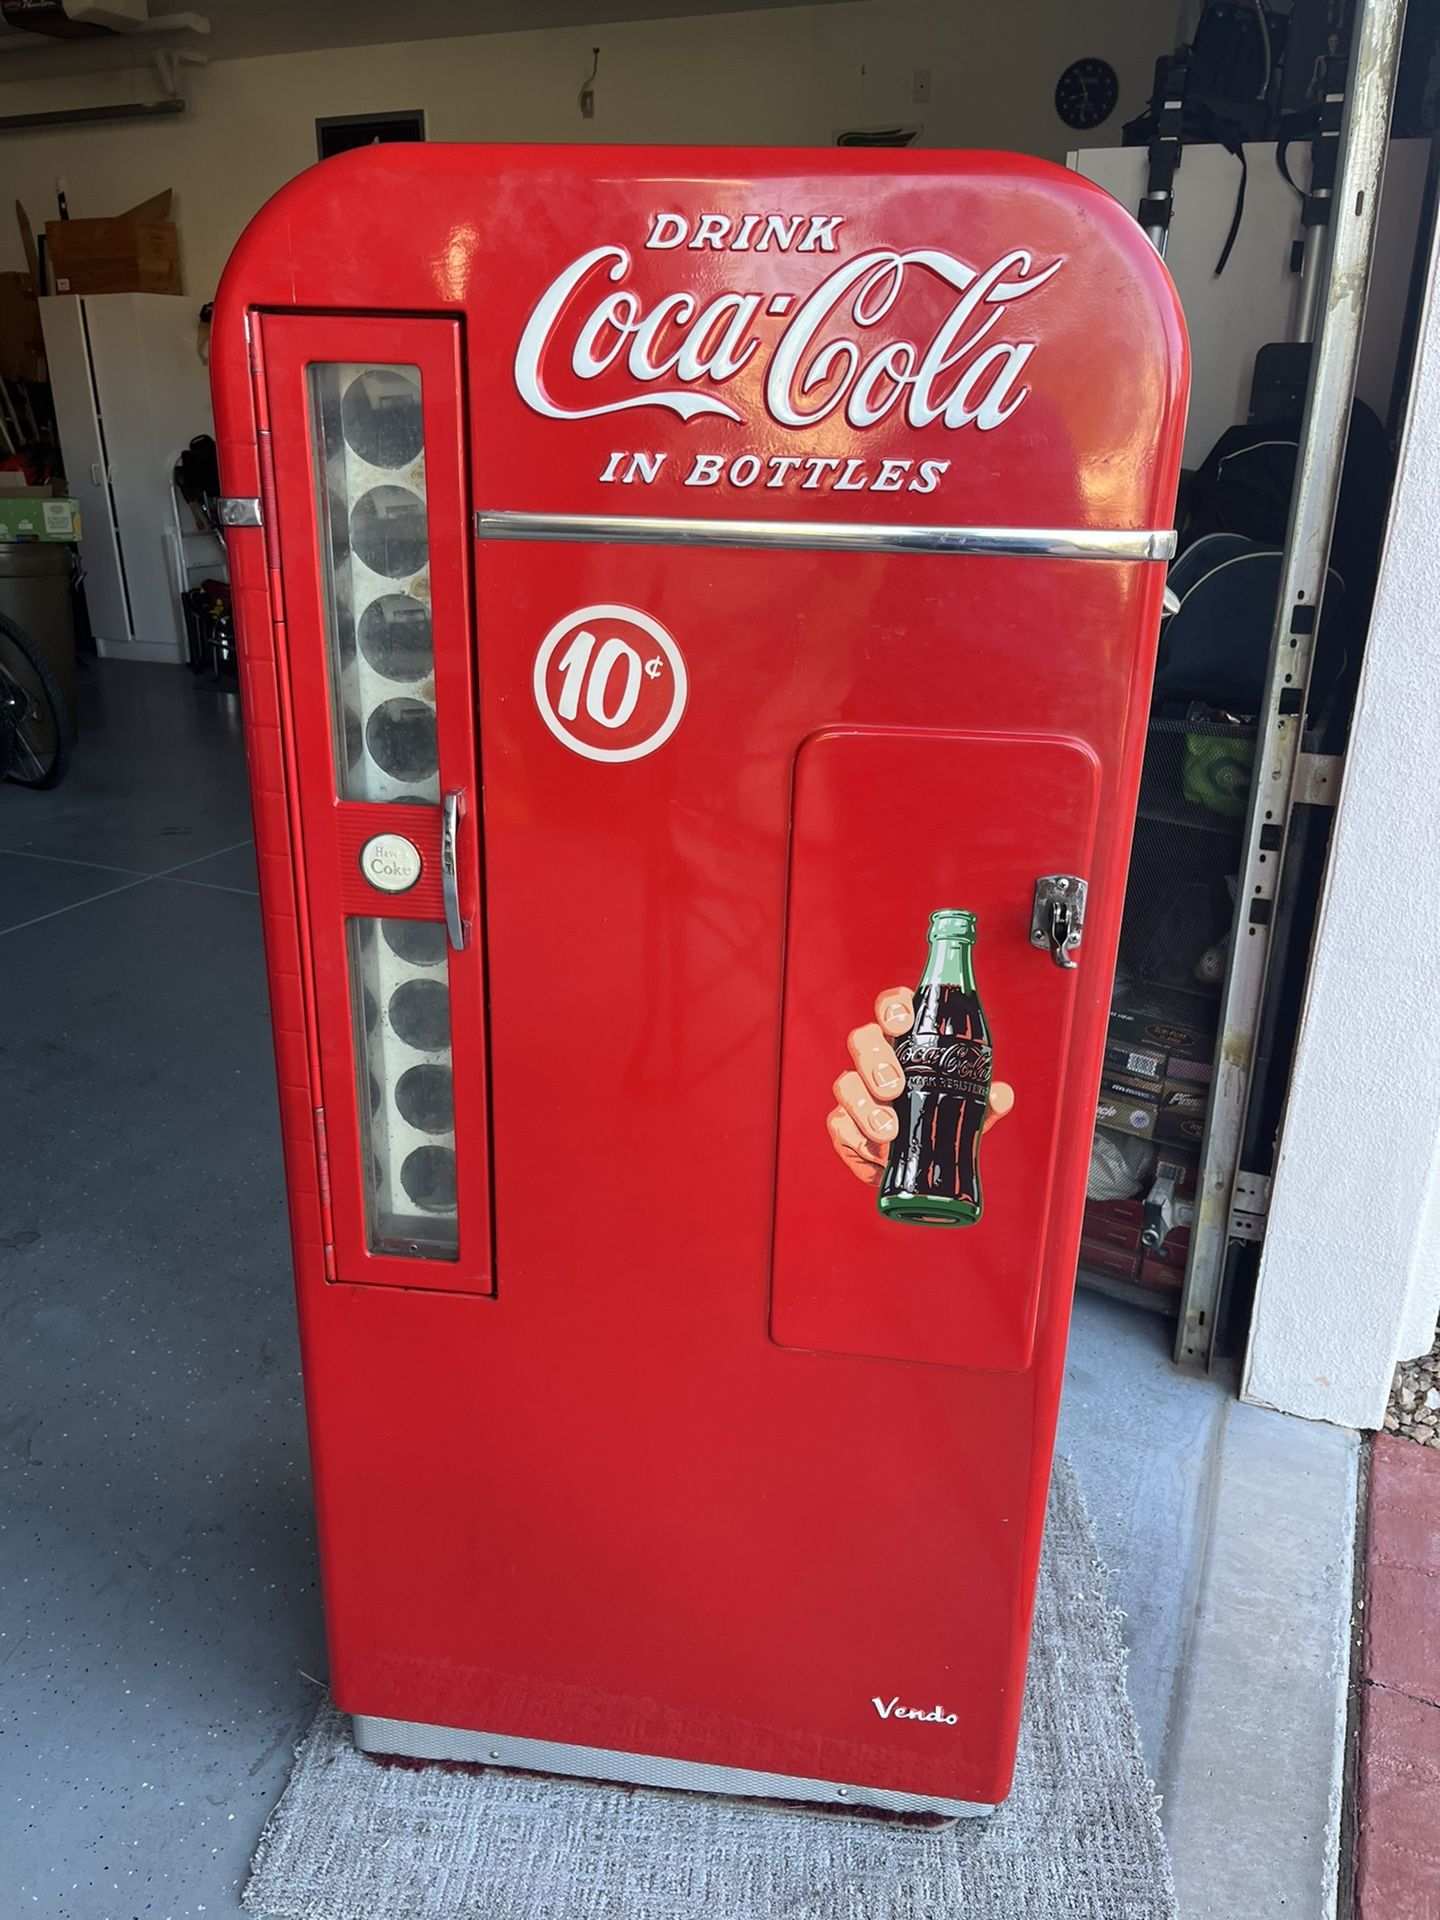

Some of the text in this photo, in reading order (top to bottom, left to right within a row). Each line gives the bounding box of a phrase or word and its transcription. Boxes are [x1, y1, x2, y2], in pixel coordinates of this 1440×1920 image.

[645, 213, 843, 252] DRINK
[514, 245, 1064, 430] Coca-Cola
[599, 452, 950, 495] IN BOTTLES
[370, 858, 412, 876] Coke
[871, 1696, 958, 1725] Vendo
